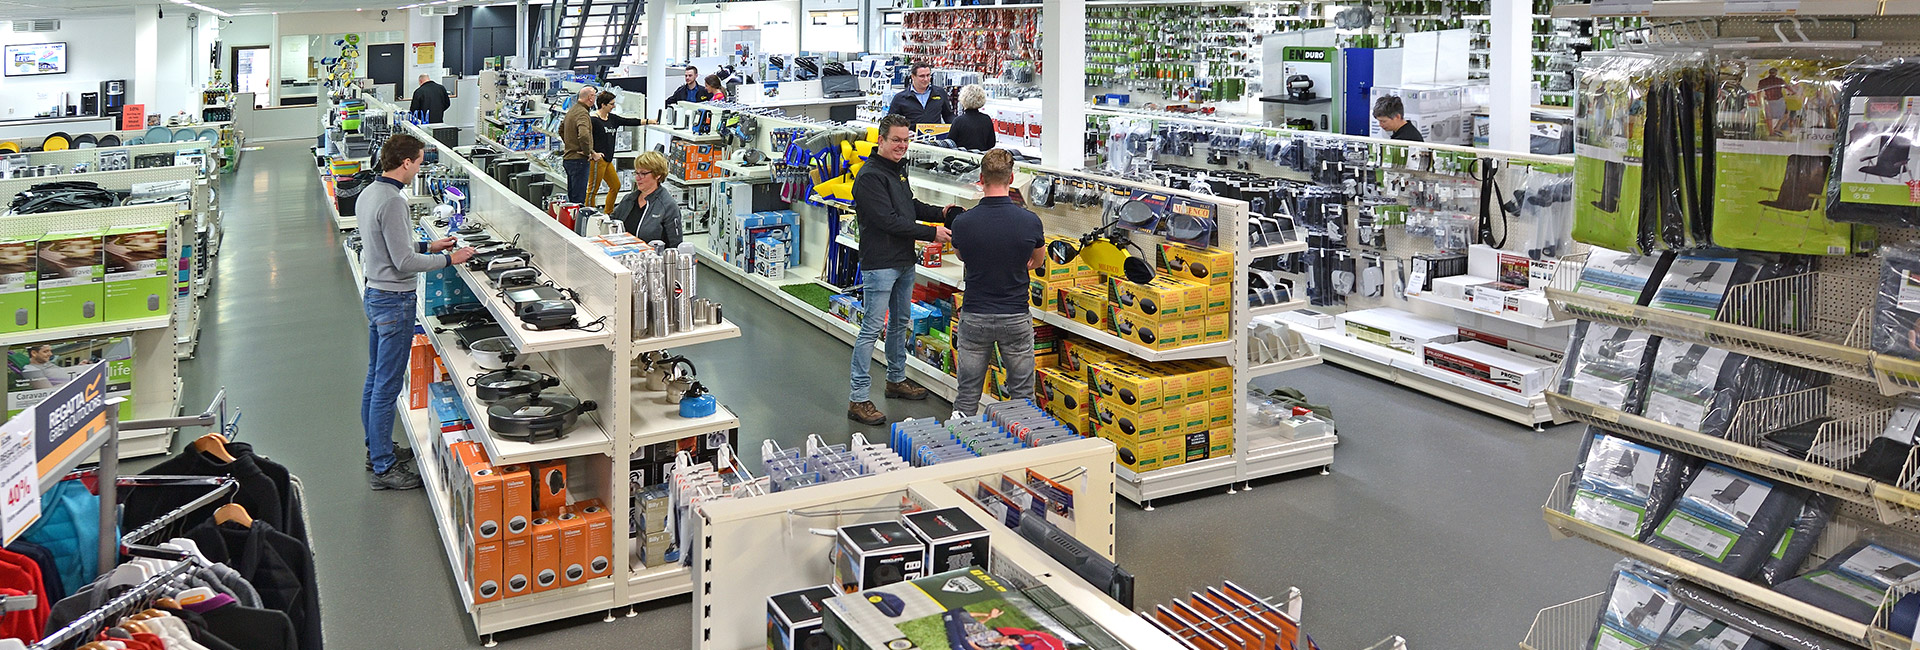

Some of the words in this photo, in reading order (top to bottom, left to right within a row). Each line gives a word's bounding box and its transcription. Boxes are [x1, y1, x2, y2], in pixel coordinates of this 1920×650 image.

[1289, 49, 1325, 60] ENDURO
[1099, 264, 1119, 273] MILENCO
[16, 390, 48, 400] Caravan
[49, 391, 85, 429] REGATTA
[49, 419, 68, 442] GREAT
[69, 395, 102, 427] OUTDOORS
[8, 477, 30, 505] 40%
